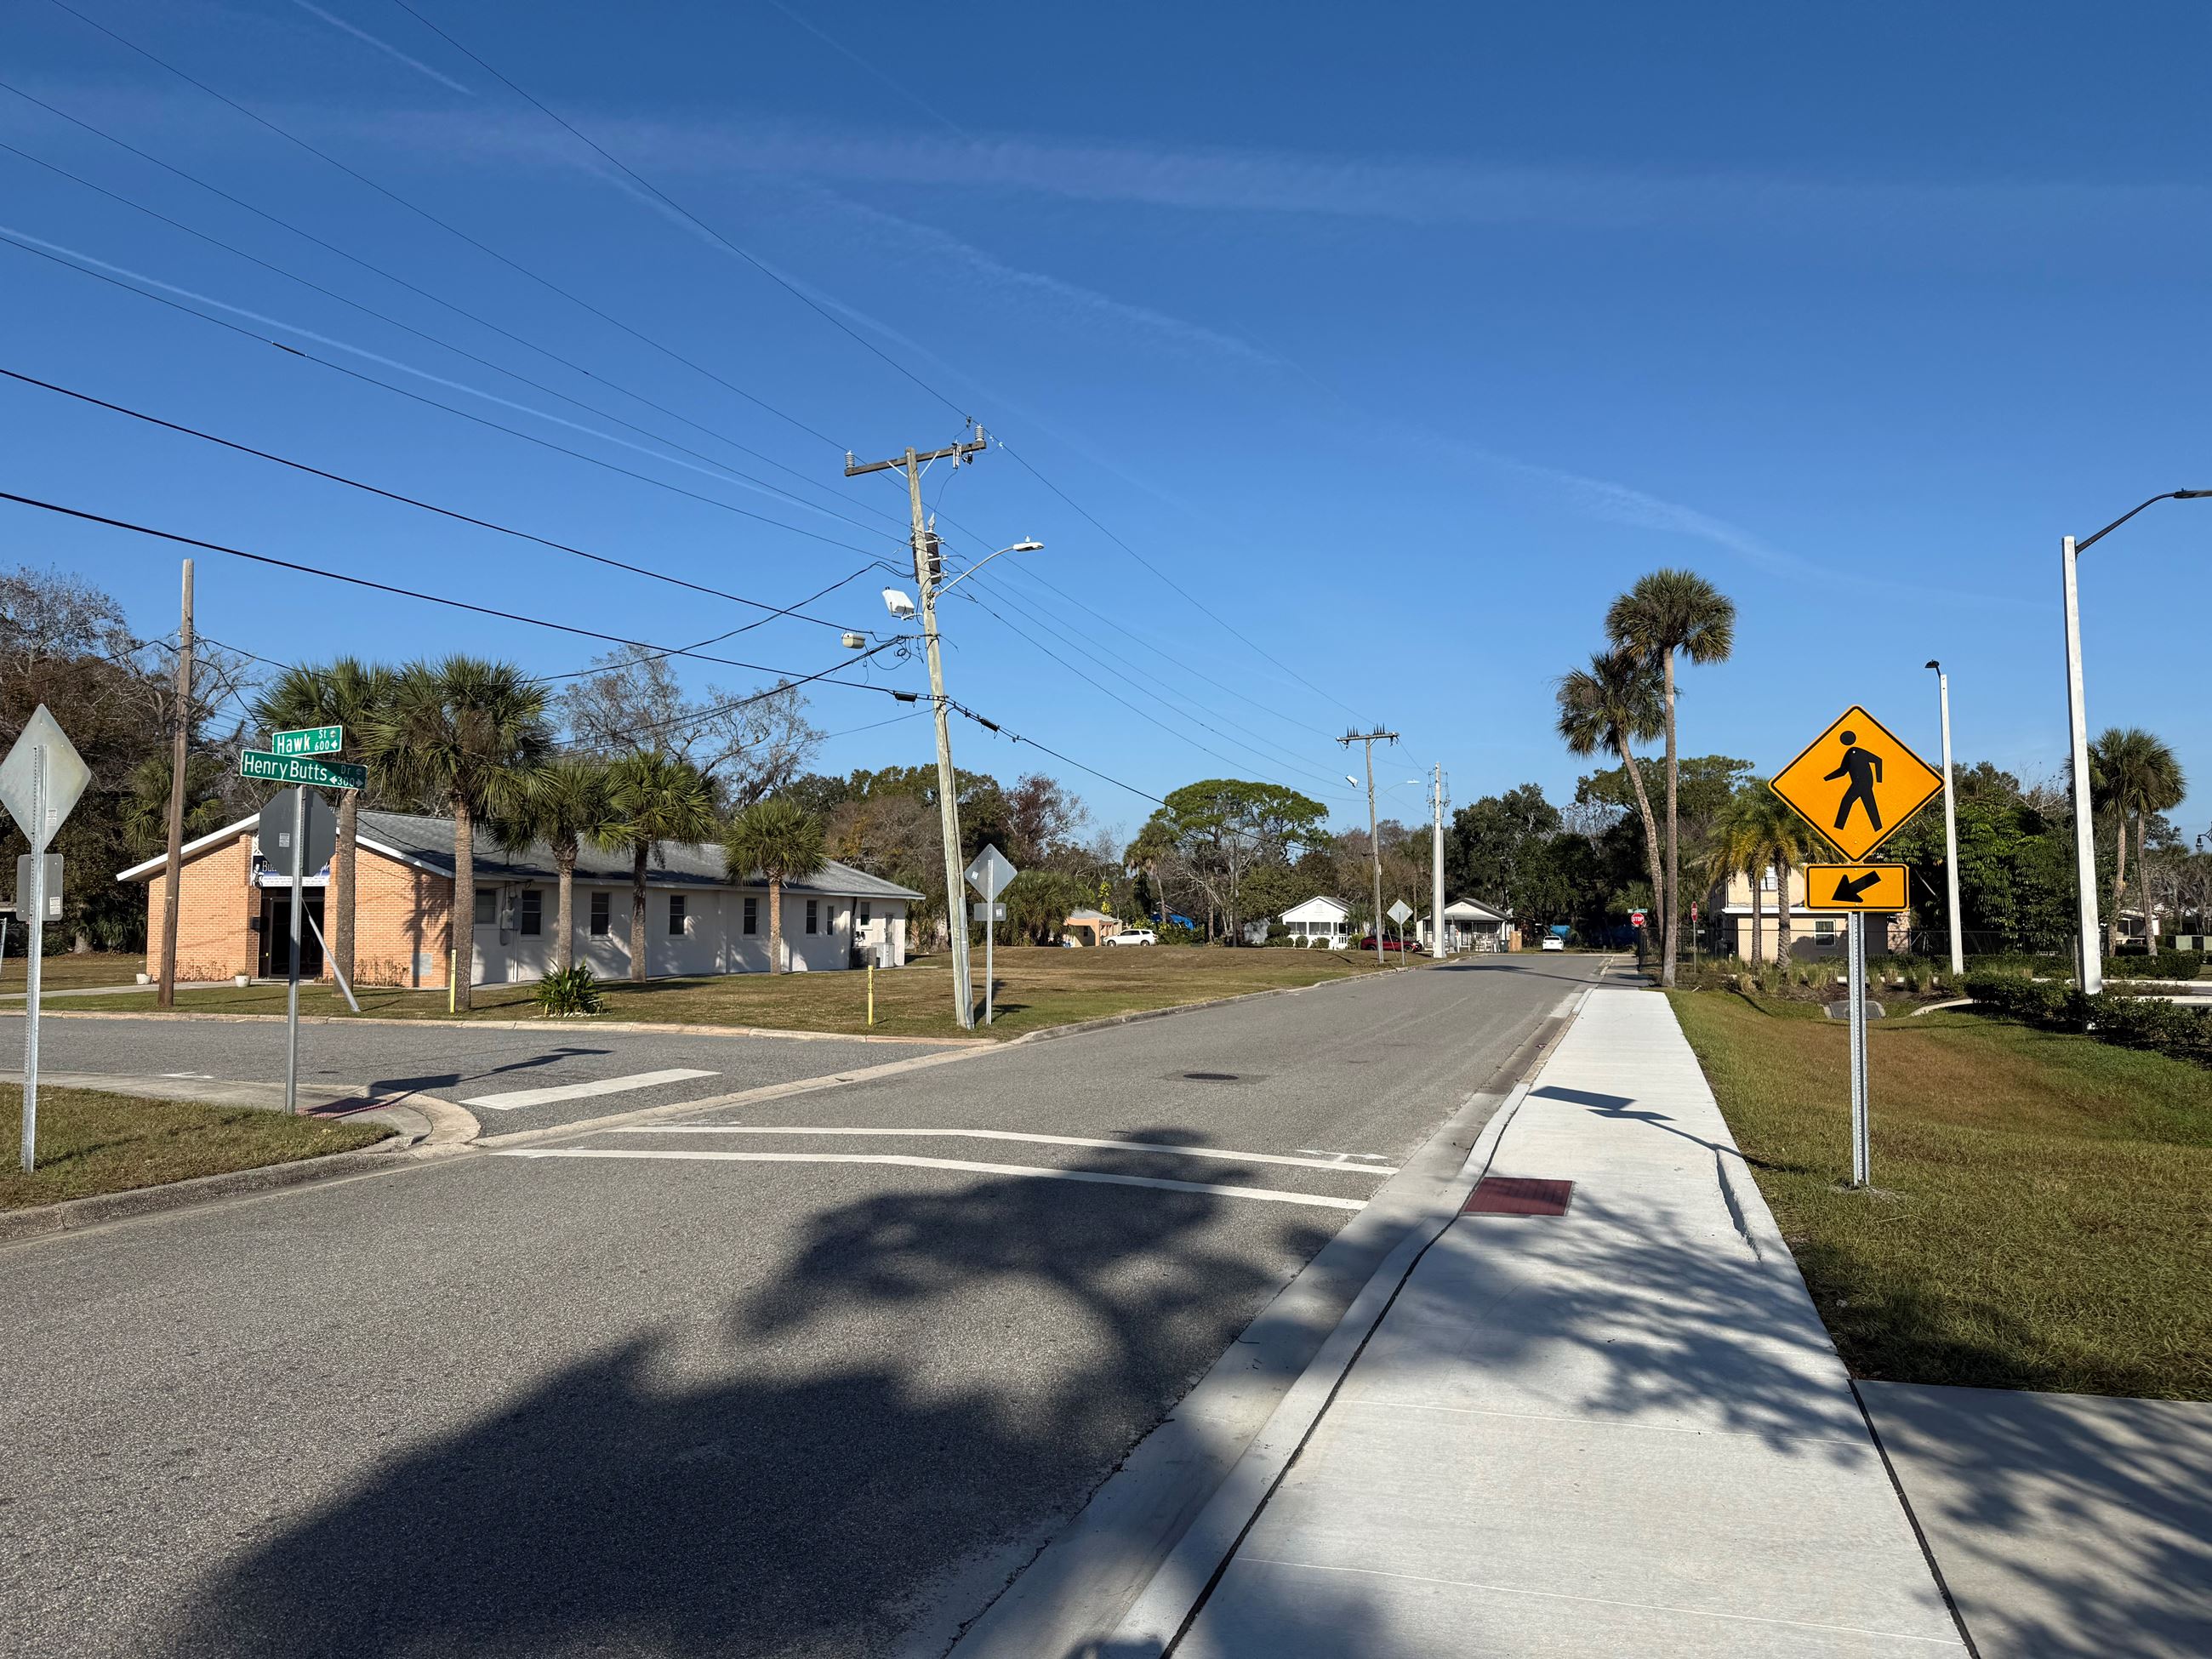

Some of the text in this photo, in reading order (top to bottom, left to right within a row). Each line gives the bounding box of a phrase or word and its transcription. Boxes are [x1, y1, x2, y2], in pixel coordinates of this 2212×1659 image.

[276, 729, 327, 754] Hawk St
[314, 740, 330, 750] 600
[244, 754, 351, 781] Henry Butts Dr
[337, 776, 355, 788] 300
